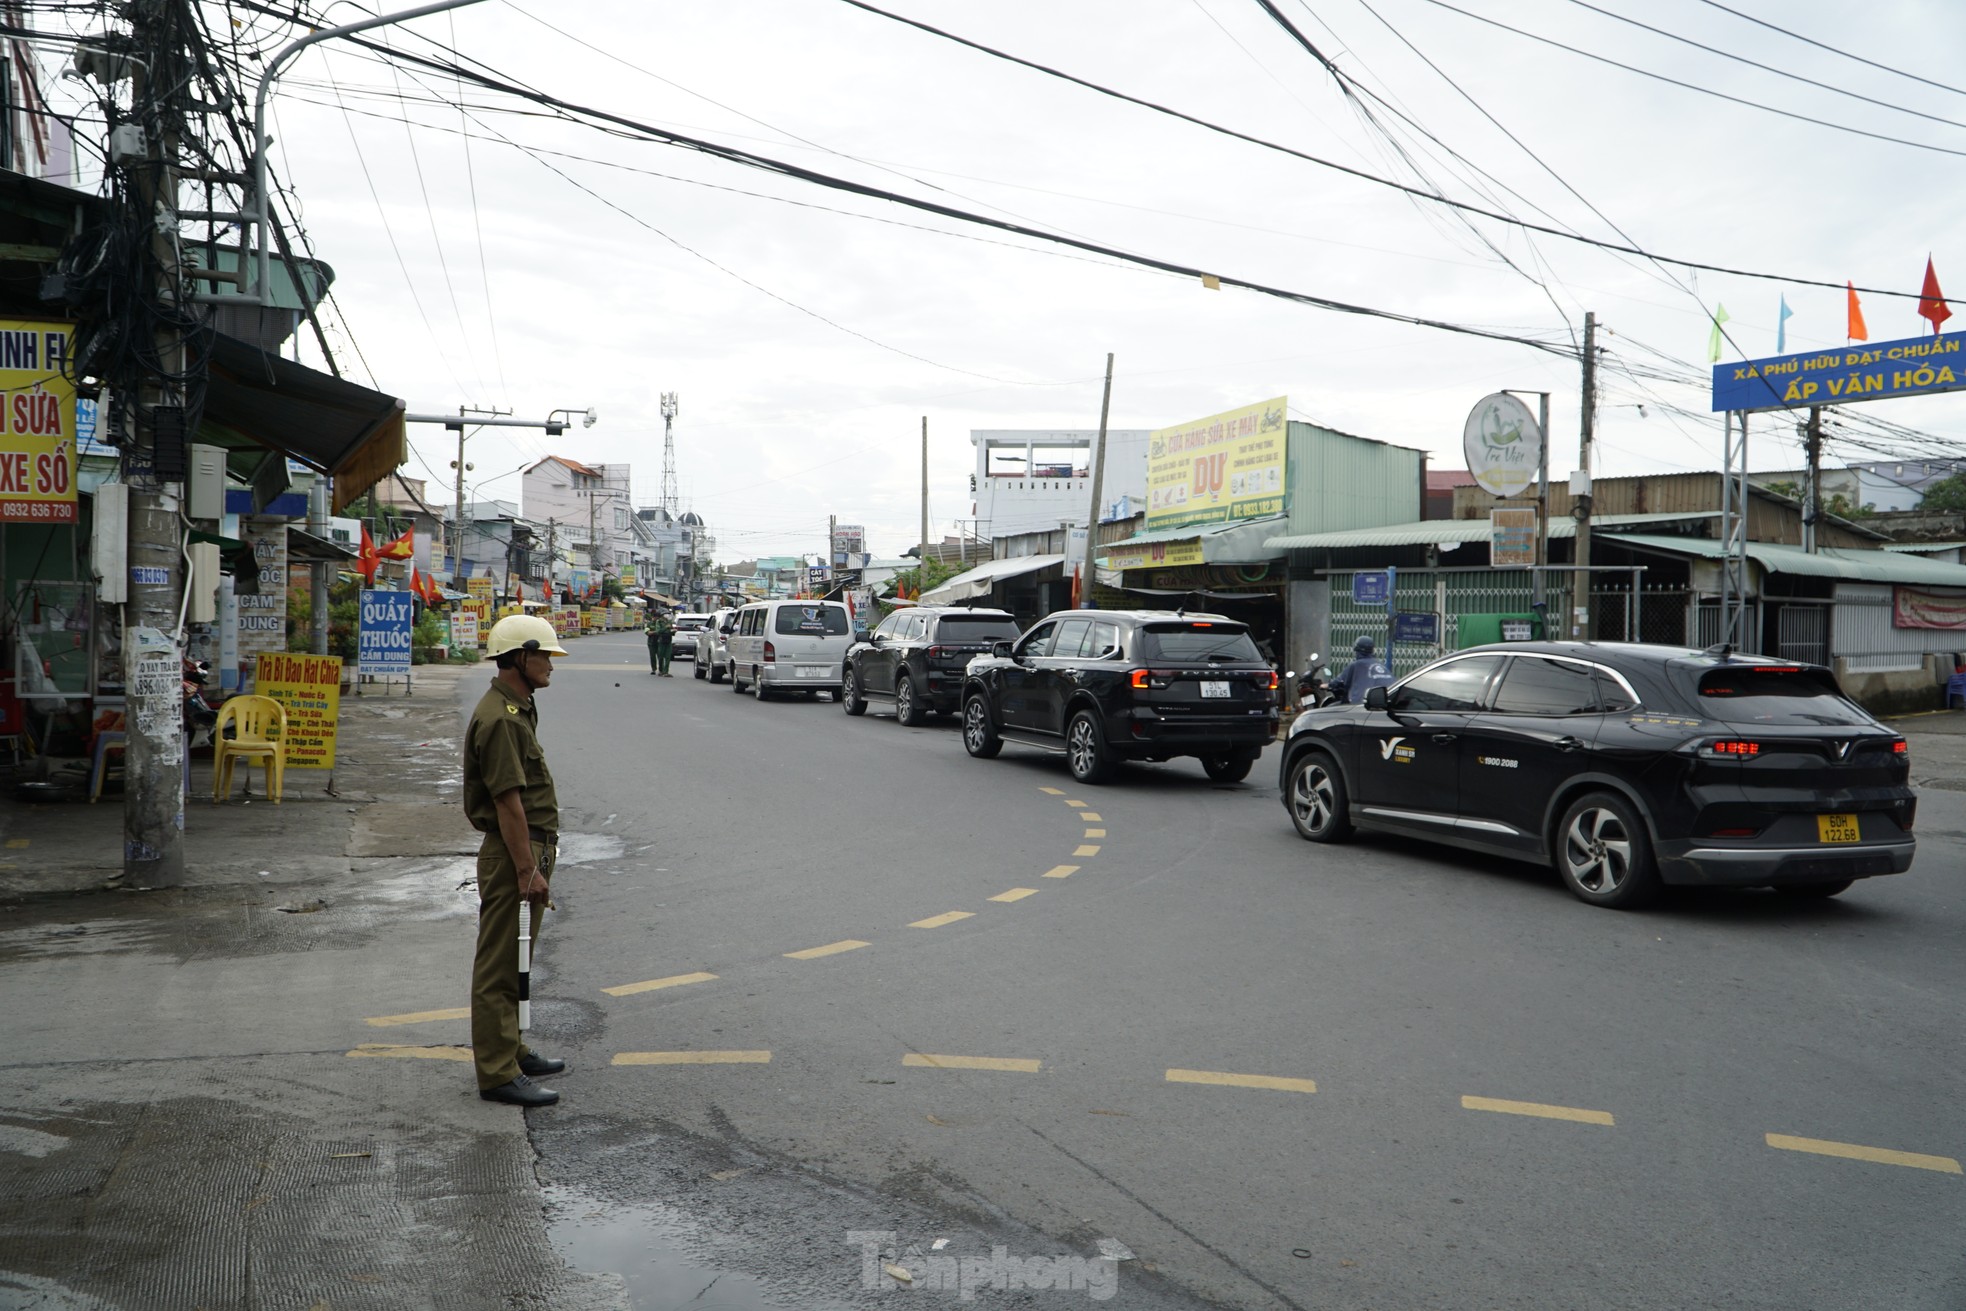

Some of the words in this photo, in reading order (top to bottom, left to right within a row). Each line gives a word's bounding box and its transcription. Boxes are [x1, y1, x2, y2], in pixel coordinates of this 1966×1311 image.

[1764, 358, 1798, 376] PHÚ
[1804, 355, 1840, 371] HỮU
[1846, 350, 1882, 368] ĐẠT
[1888, 336, 1960, 360] CHUẨN
[1784, 376, 1819, 401] ẤP
[1827, 372, 1883, 395] VĂN
[1893, 362, 1955, 389] HÓA
[14, 382, 61, 434] SỬA
[1168, 429, 1183, 454] CỬA
[1184, 426, 1206, 451] HÀNG
[1208, 419, 1224, 444] SỬA
[1226, 420, 1236, 440] XE
[1239, 411, 1259, 437] MÁY
[0, 453, 28, 492] XE
[37, 440, 69, 494] SỐ
[1484, 444, 1503, 463] Tre
[1504, 445, 1525, 465] Việt
[1192, 451, 1228, 502] DỰ
[4, 504, 29, 517] 0932
[31, 504, 50, 517] 636
[52, 504, 71, 518] 730
[364, 595, 409, 624] QUẦY
[361, 623, 410, 648] THUỐC
[259, 655, 272, 682] Trà
[274, 655, 285, 682] Bí
[320, 659, 340, 685] Chia
[384, 651, 410, 660] DUNG
[1484, 756, 1501, 766] 1900
[1501, 758, 1519, 768] 2088
[1824, 828, 1857, 842] 122.68
[1829, 815, 1848, 828] 60H
